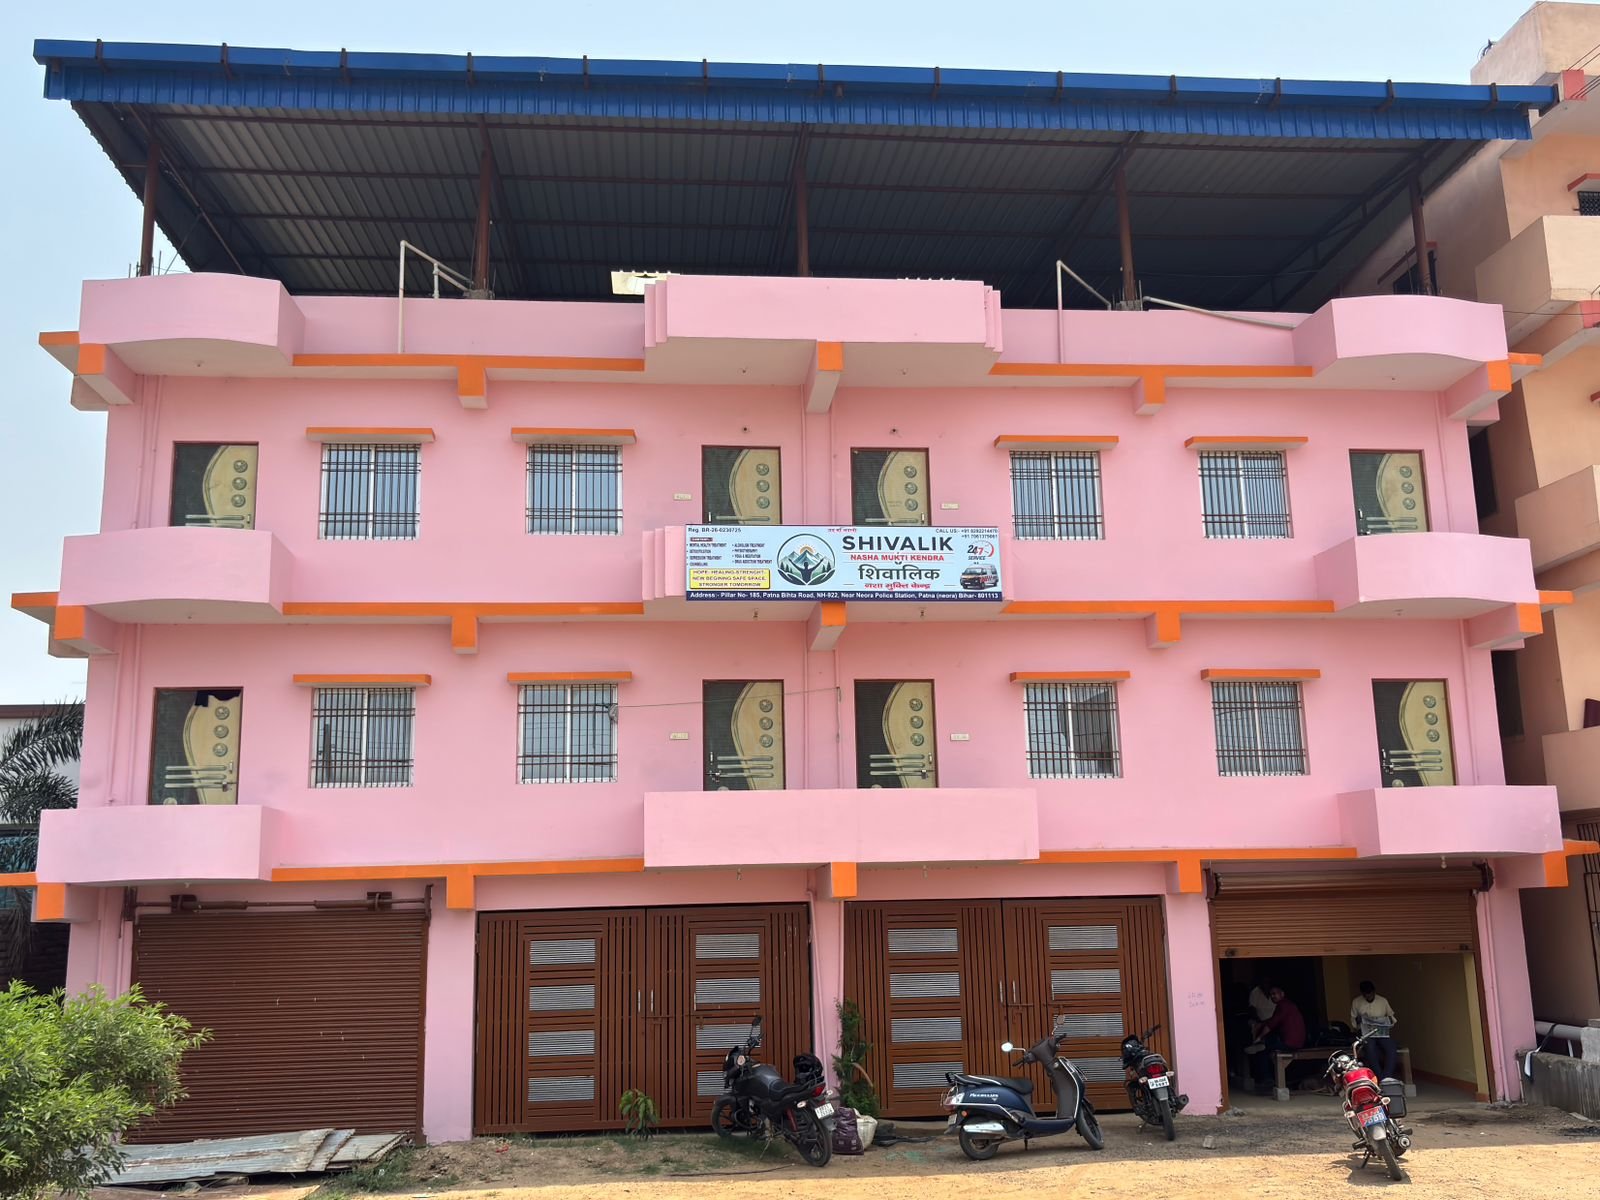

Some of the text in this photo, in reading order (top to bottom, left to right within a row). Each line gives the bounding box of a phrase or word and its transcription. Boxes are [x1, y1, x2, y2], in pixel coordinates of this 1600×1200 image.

[842, 536, 953, 551] SHIVALIK
[858, 564, 940, 580] शिवालिक
[886, 582, 908, 590] मुक्ति
